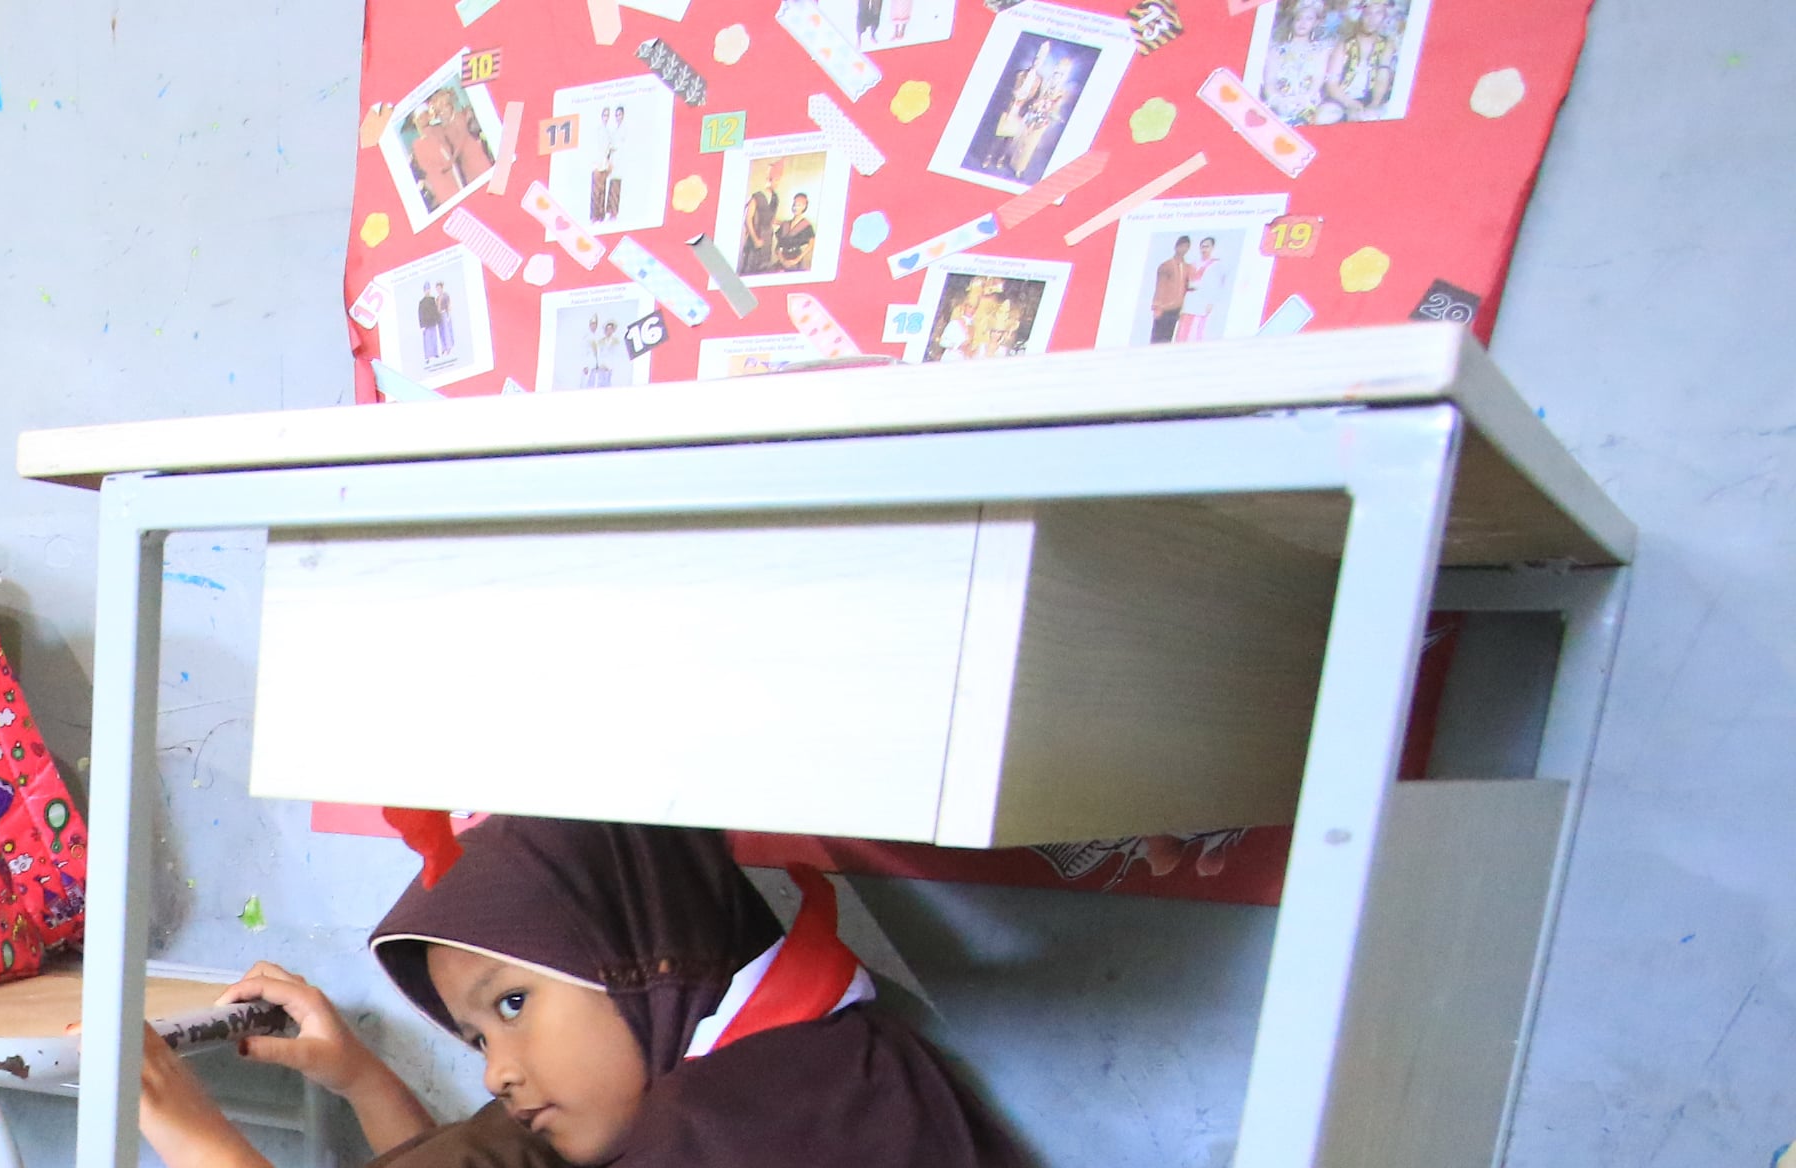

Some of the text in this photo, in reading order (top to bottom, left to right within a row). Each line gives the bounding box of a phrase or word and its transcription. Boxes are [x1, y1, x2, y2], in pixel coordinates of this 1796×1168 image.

[1138, 4, 1171, 41] 13
[468, 53, 494, 81] 10
[546, 121, 572, 147] 11
[706, 117, 738, 148] 12
[1271, 222, 1313, 250] 19
[354, 286, 386, 323] 15
[1419, 293, 1473, 326] 20
[626, 316, 663, 354] 16
[892, 312, 924, 335] 18
